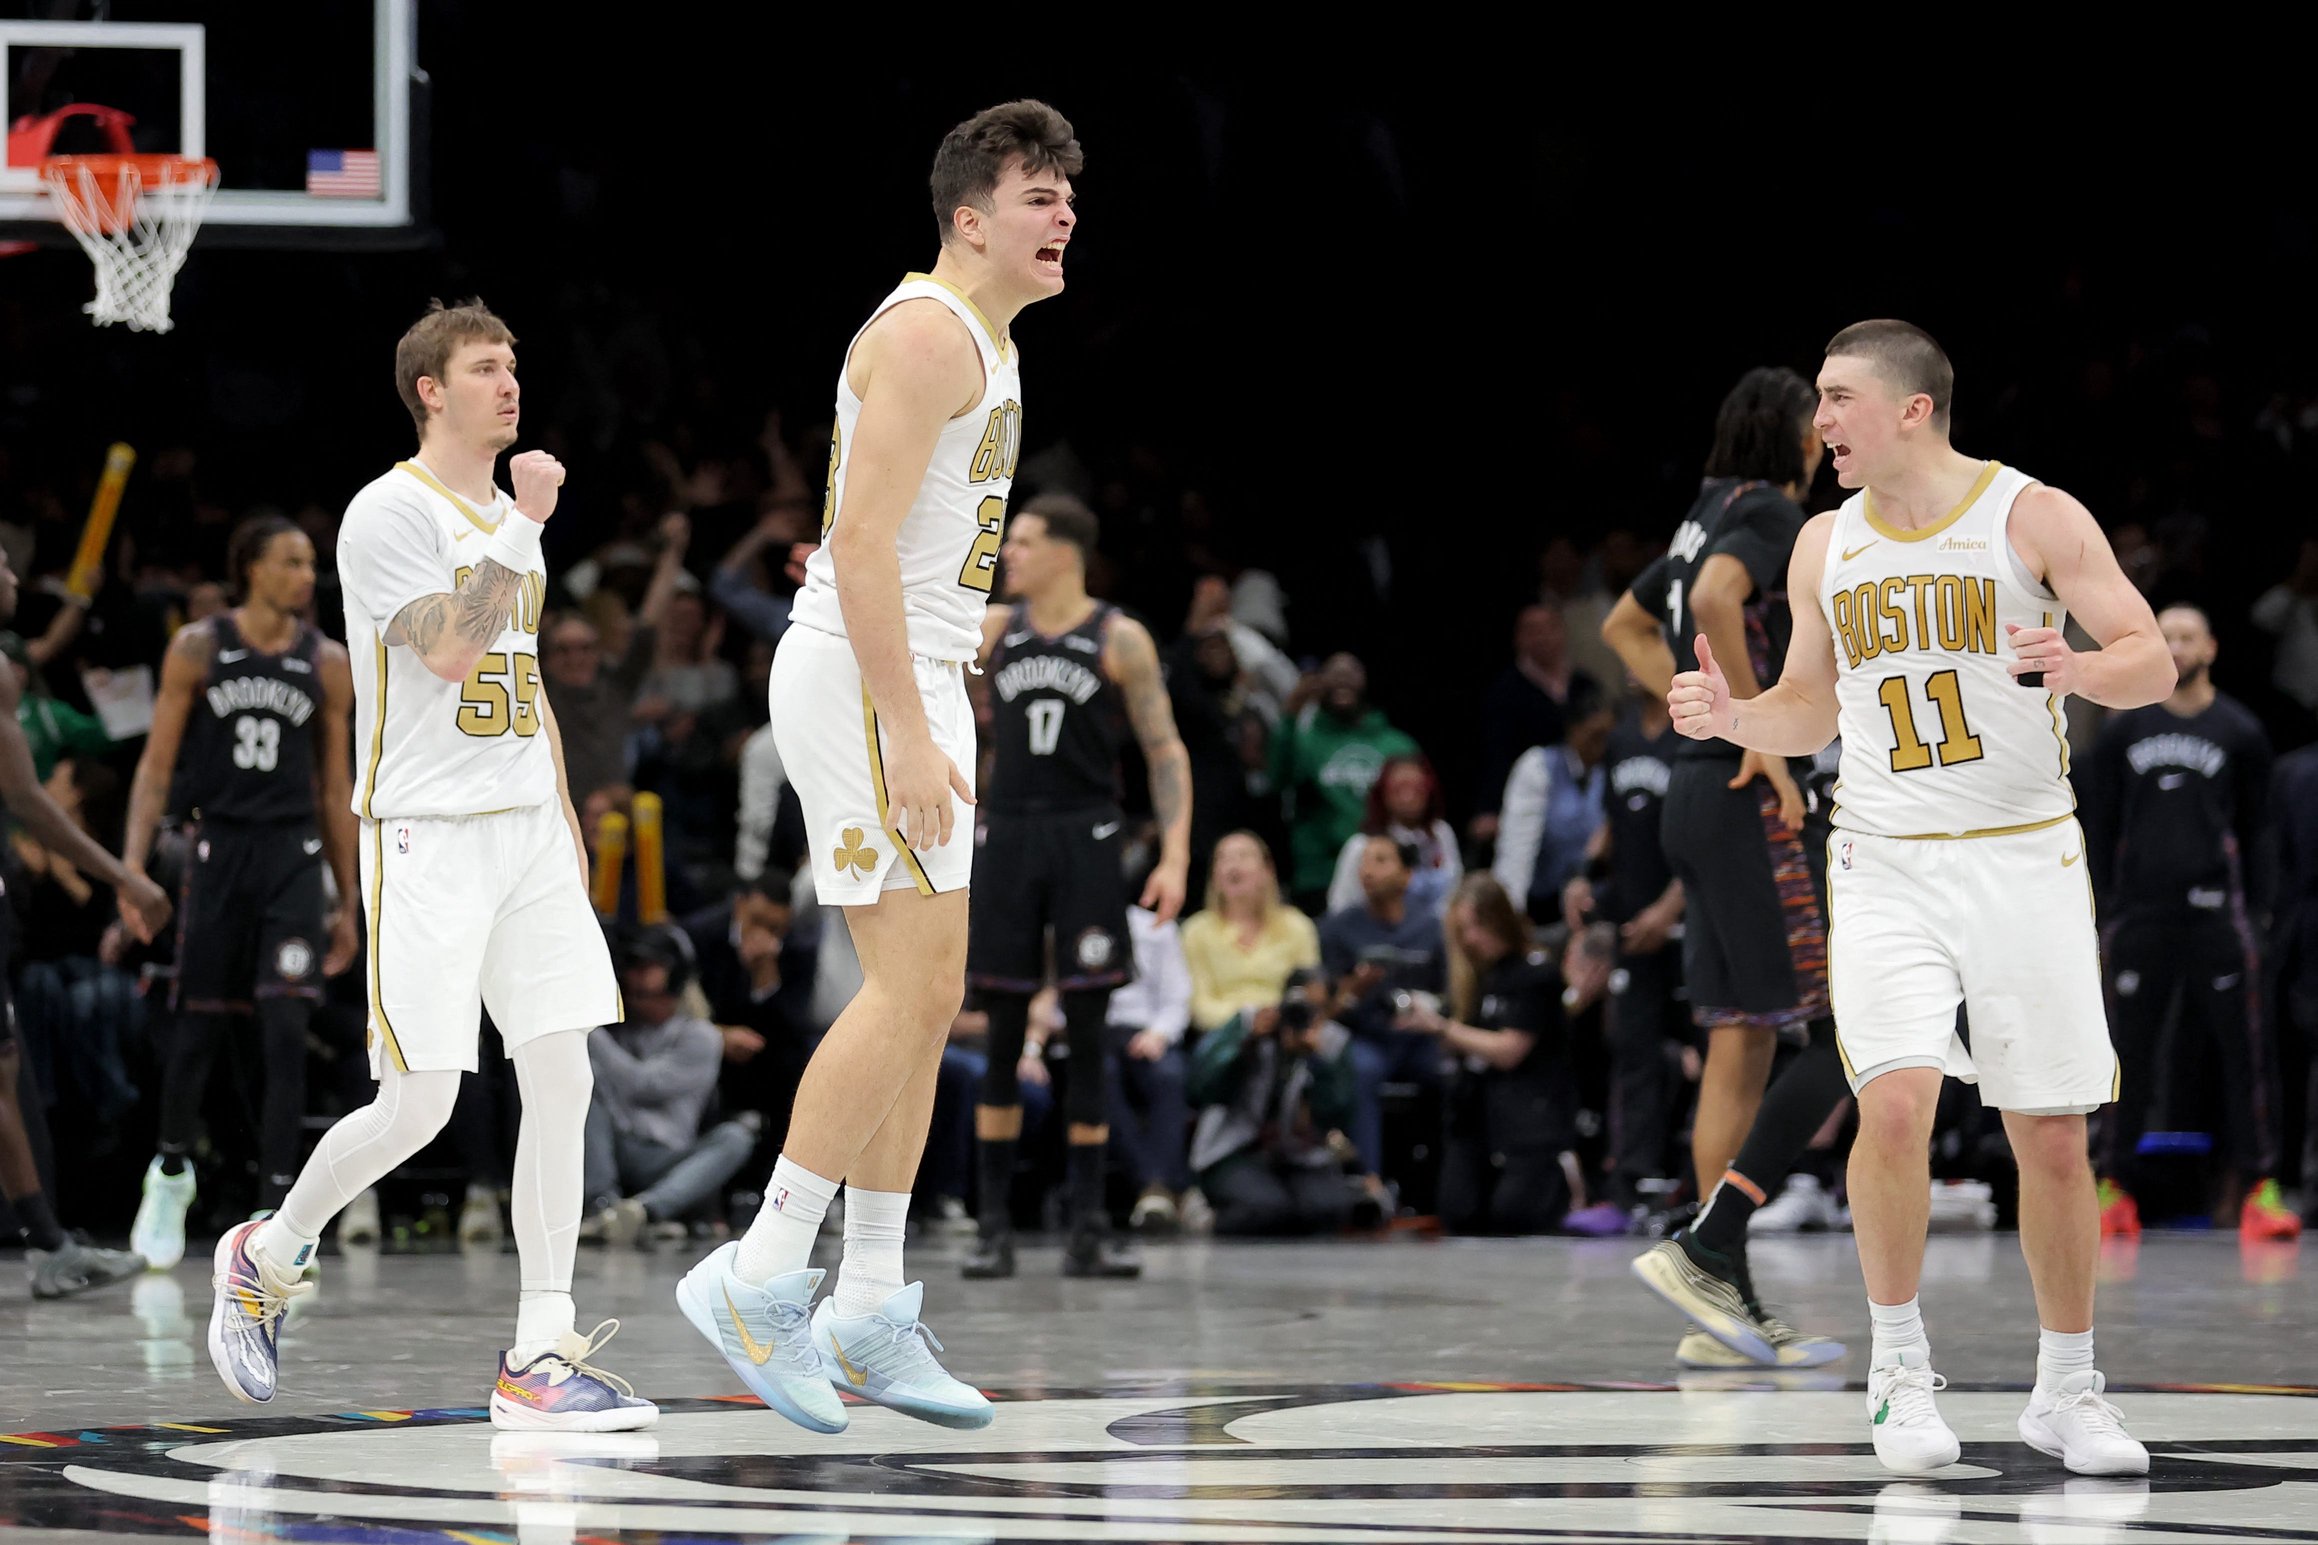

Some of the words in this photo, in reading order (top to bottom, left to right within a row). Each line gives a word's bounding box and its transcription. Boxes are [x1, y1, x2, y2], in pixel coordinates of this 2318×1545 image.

[1938, 536, 1987, 551] Amica
[1832, 574, 1997, 670] BOSTON
[455, 652, 541, 738] 55
[1024, 698, 1066, 756] 17
[1878, 669, 1984, 773] 11
[232, 714, 281, 773] 33
